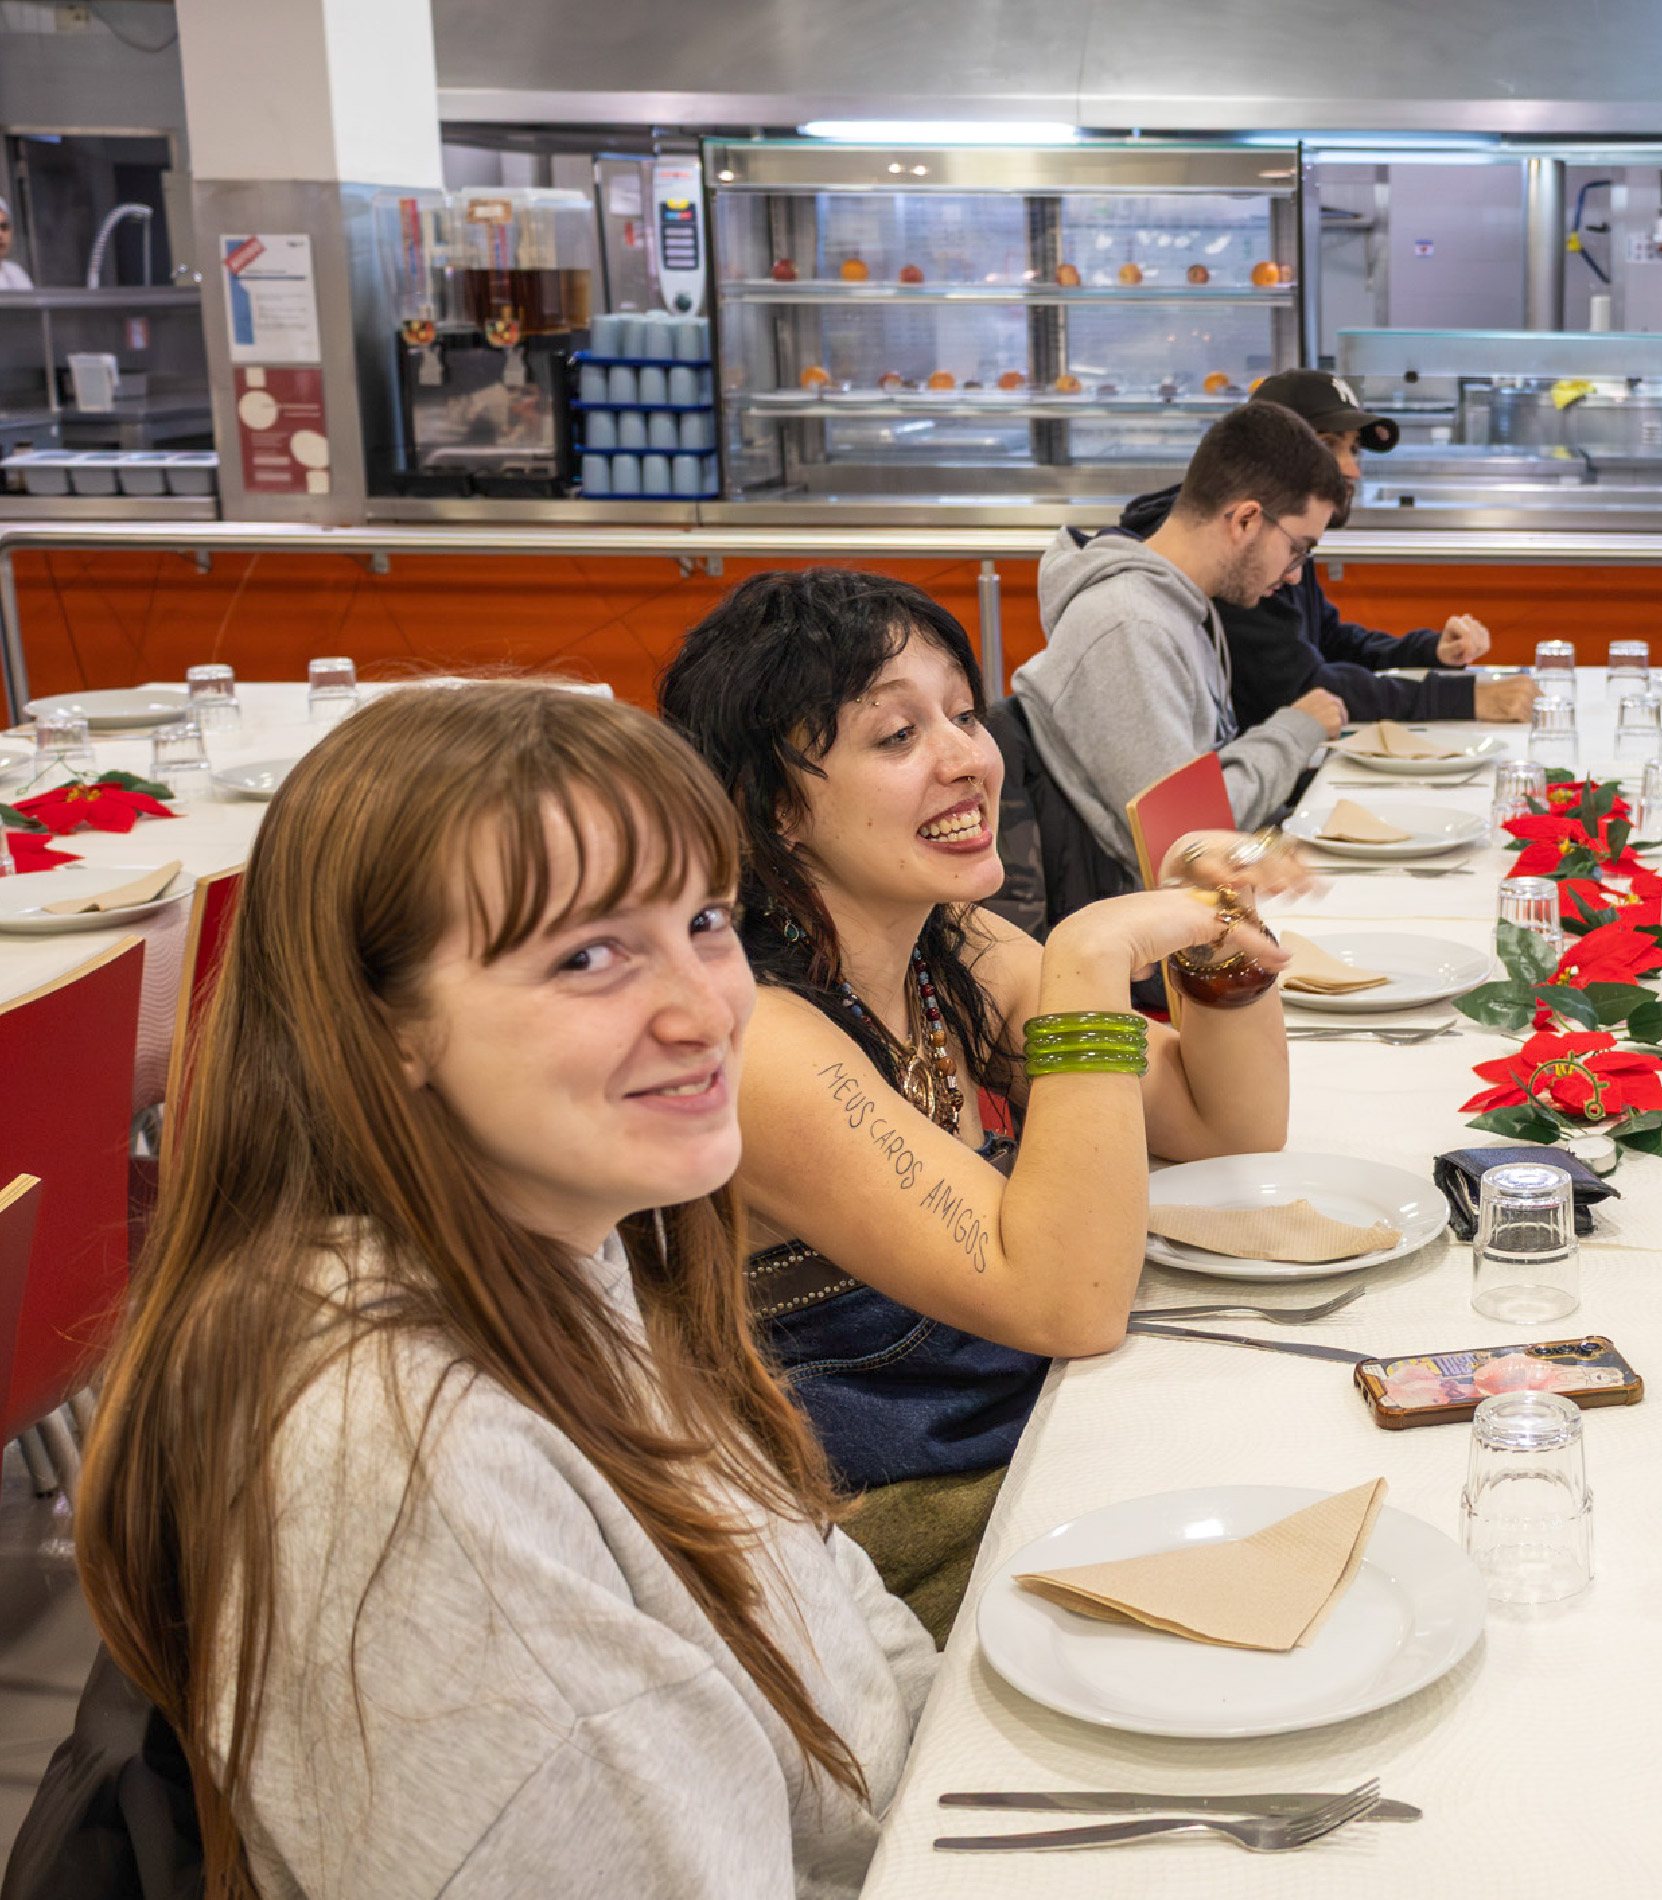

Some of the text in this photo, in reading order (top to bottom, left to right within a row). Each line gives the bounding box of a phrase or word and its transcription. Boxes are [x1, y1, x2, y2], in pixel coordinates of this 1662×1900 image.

[817, 1062, 989, 1274] MEUS CAROS AMIGOS
